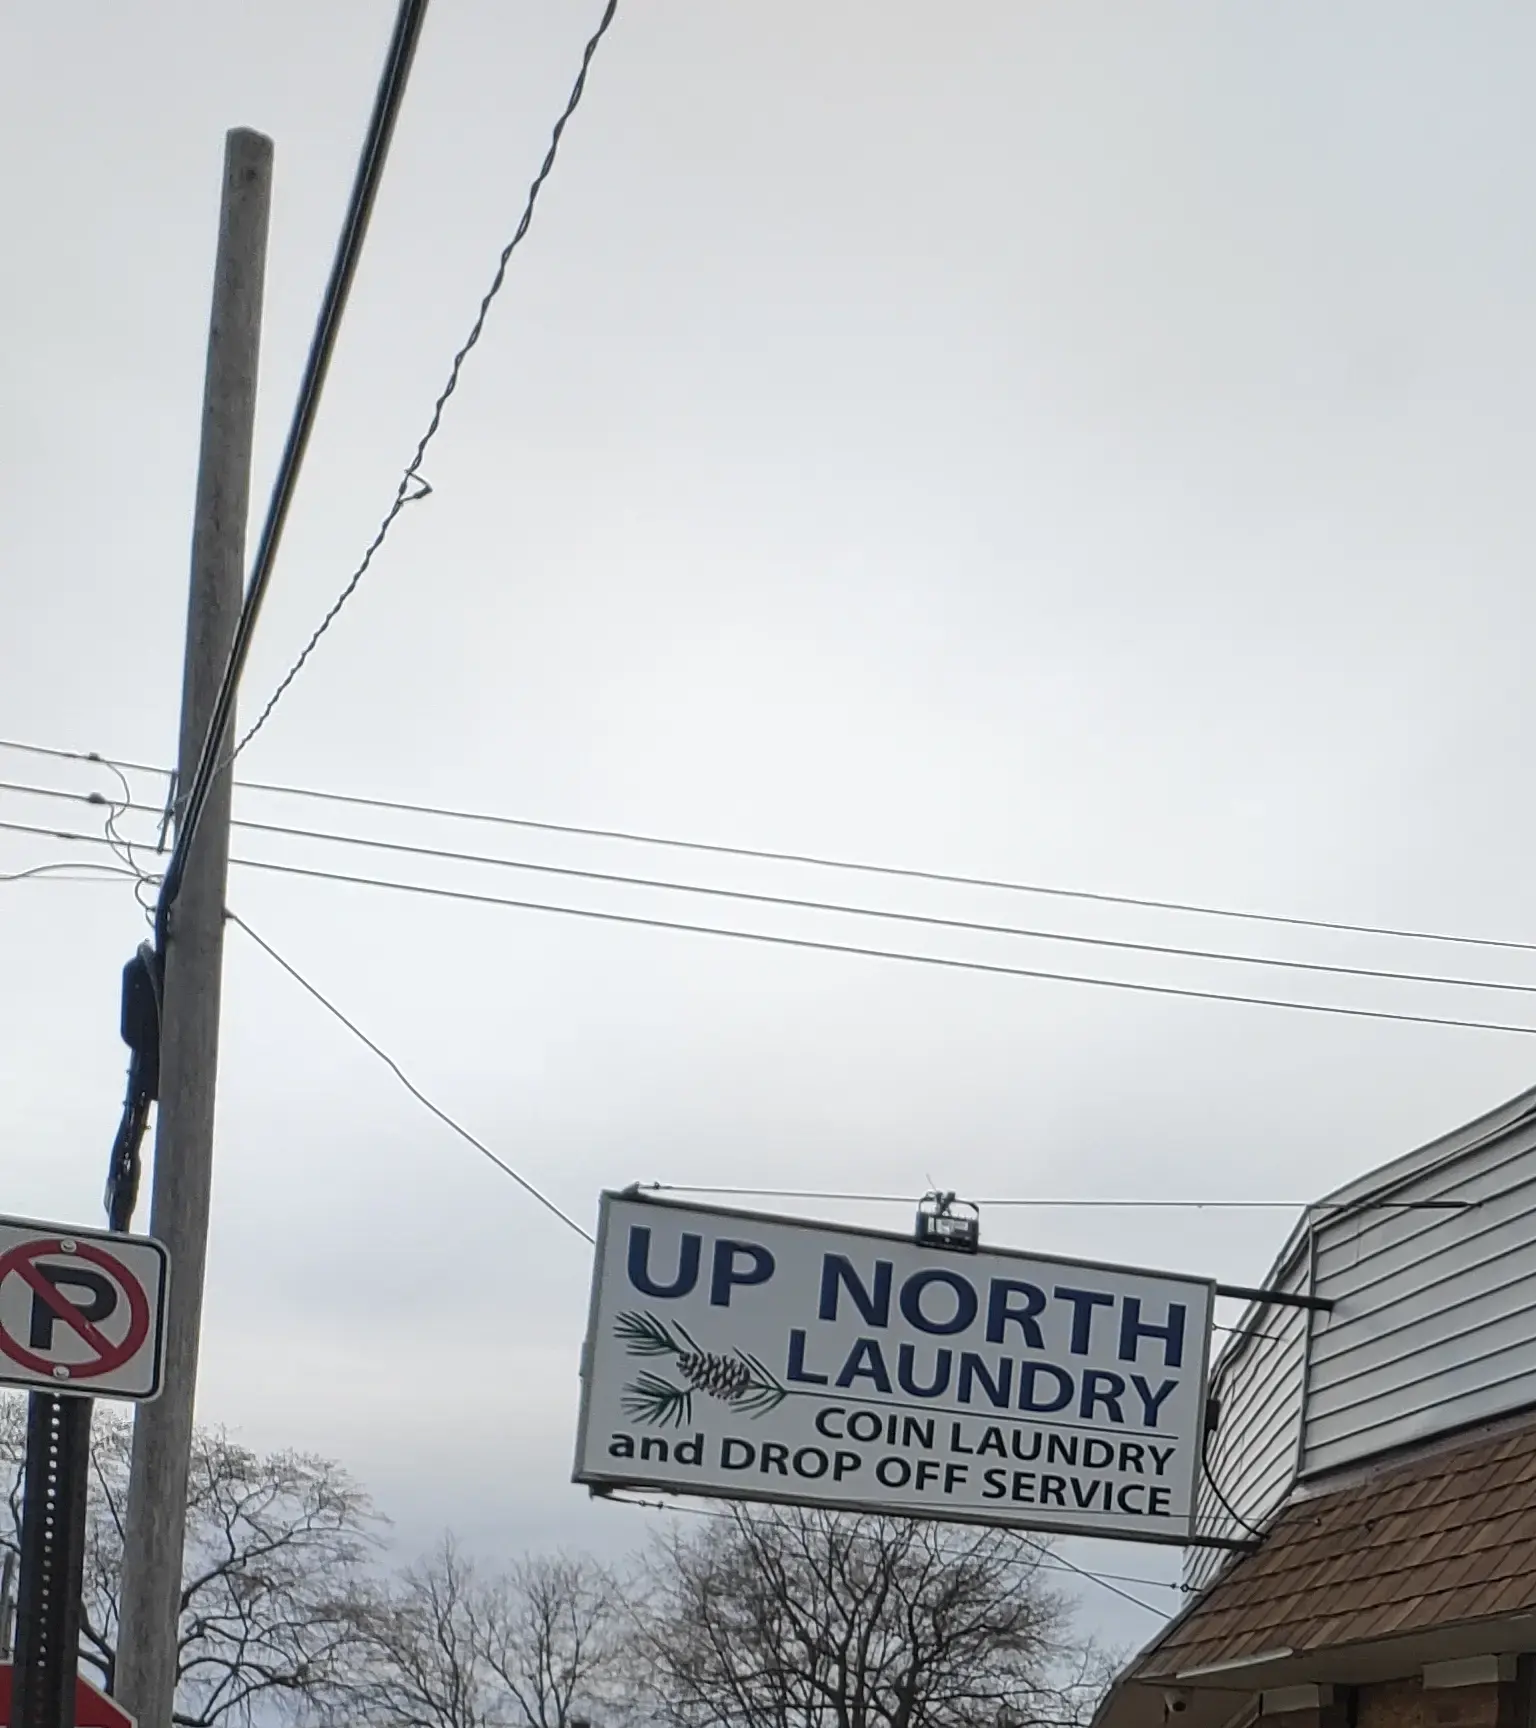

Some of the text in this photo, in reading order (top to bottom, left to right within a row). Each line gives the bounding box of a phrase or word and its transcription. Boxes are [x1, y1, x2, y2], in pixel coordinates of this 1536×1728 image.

[627, 1224, 1187, 1369] UP NORTH
[786, 1328, 1179, 1428] LAUNDRY
[608, 1431, 1172, 1517] and DROP OFF SERVICE
[815, 1406, 1176, 1477] COIN LAUNDRY
